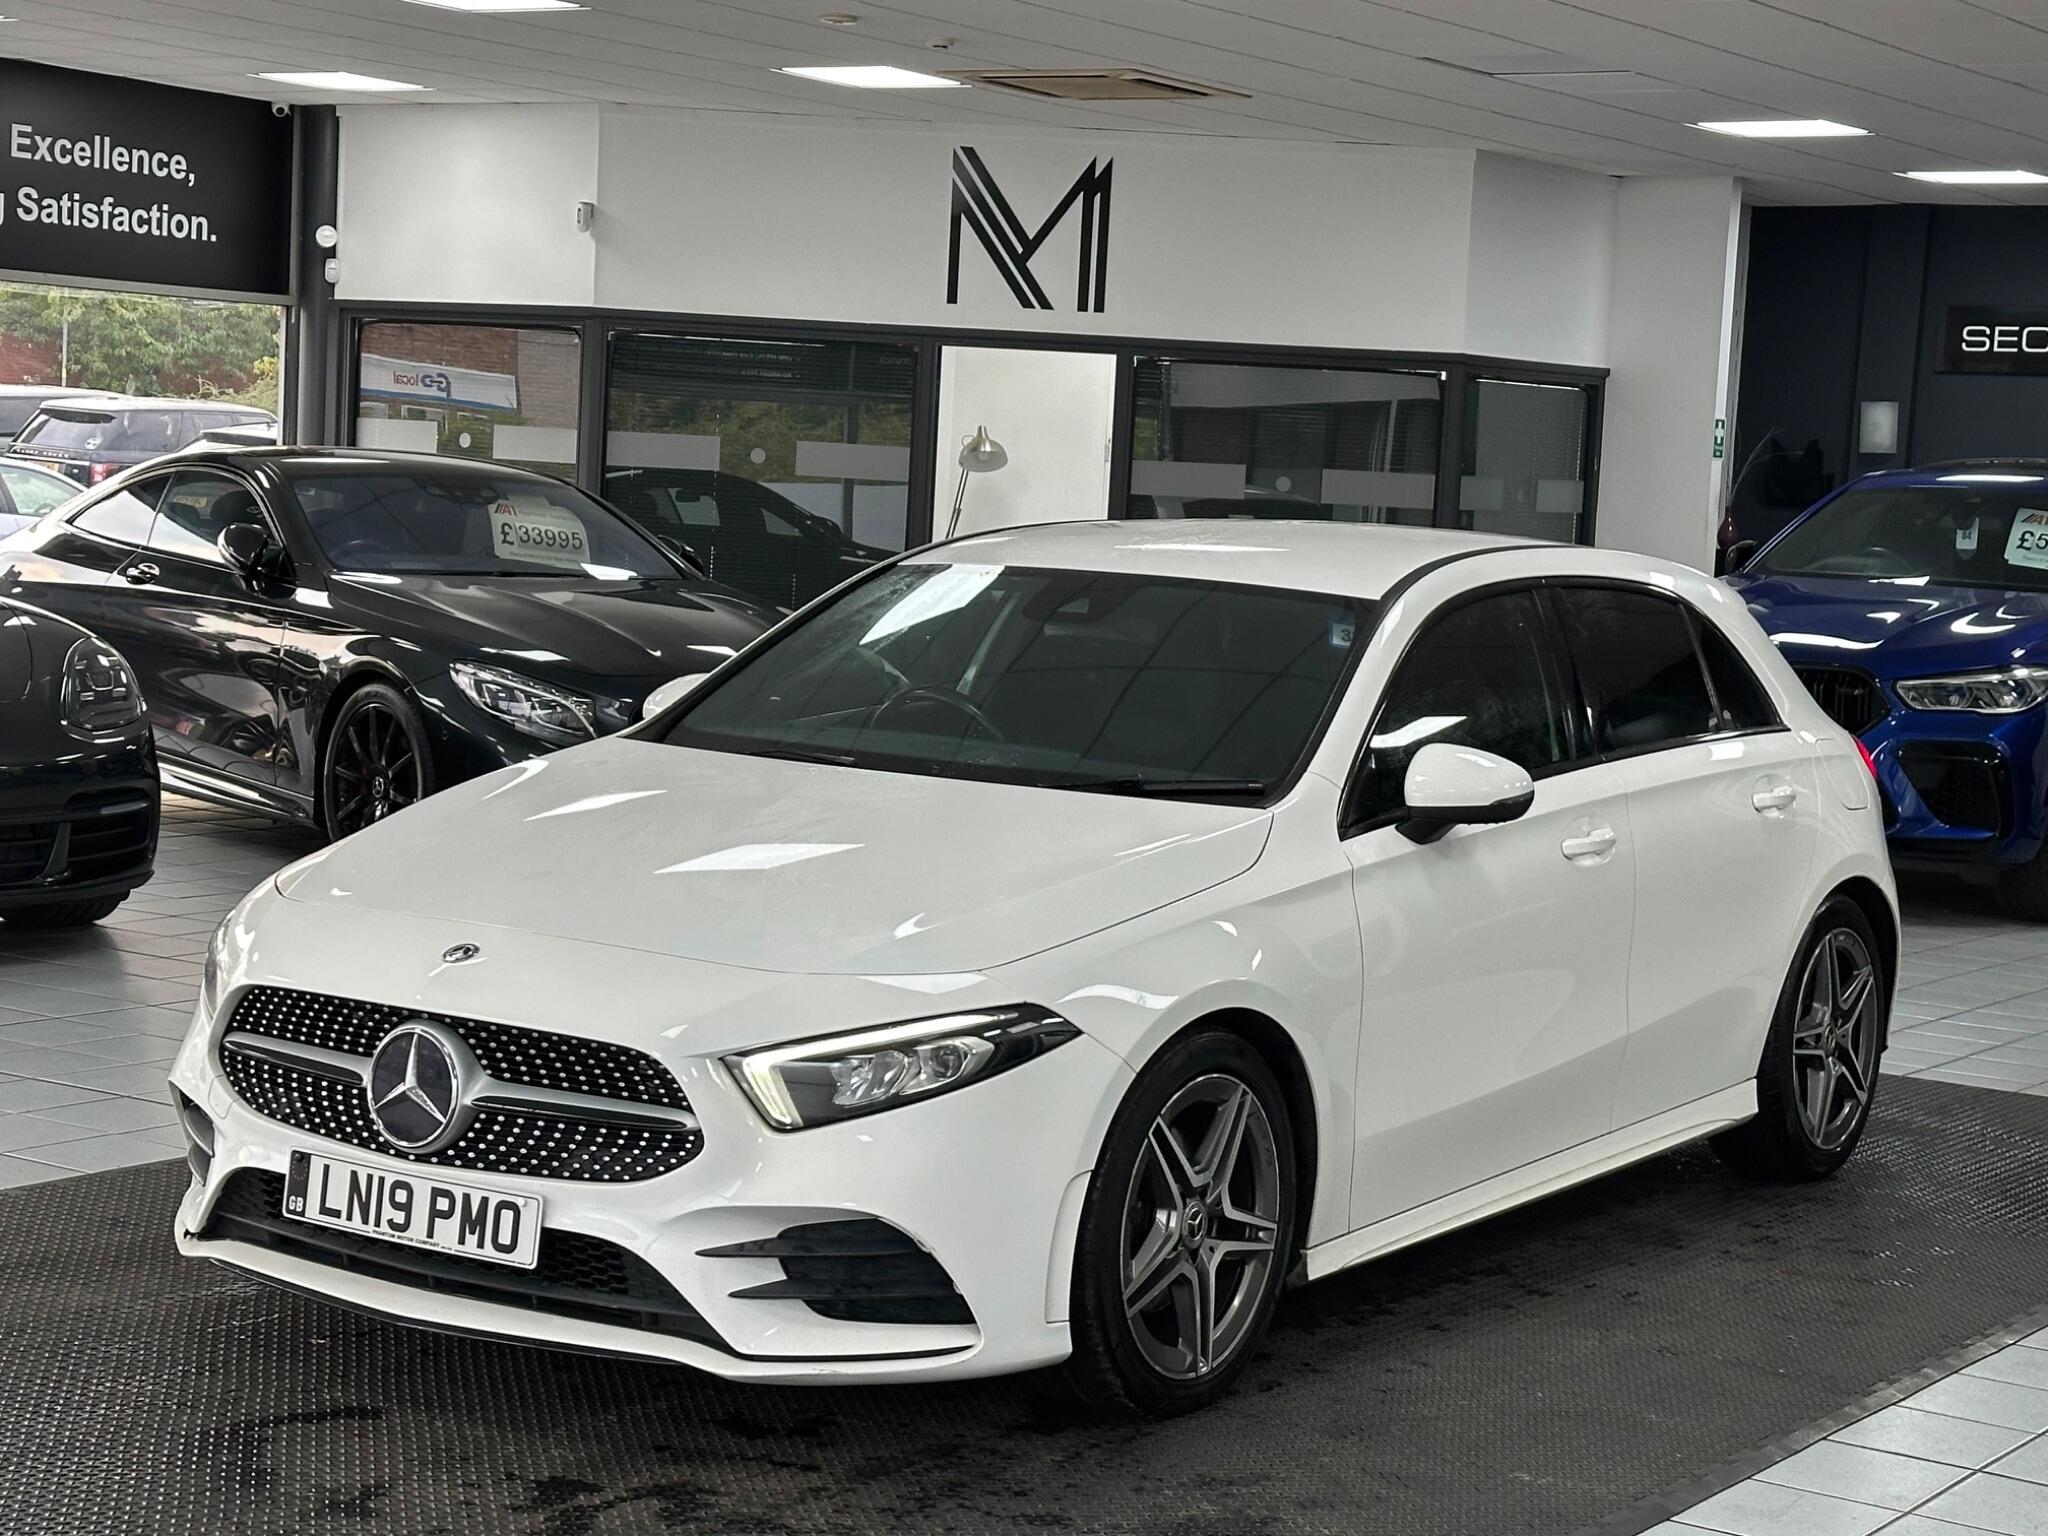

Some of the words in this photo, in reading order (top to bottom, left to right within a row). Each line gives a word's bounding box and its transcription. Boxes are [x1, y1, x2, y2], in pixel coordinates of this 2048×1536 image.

[10, 123, 195, 187] Excellence,
[16, 186, 217, 242] Satisfaction.
[500, 522, 583, 550] £33995
[288, 1194, 304, 1213] GB
[318, 1163, 414, 1234] LN19
[426, 1186, 521, 1255] PMO
